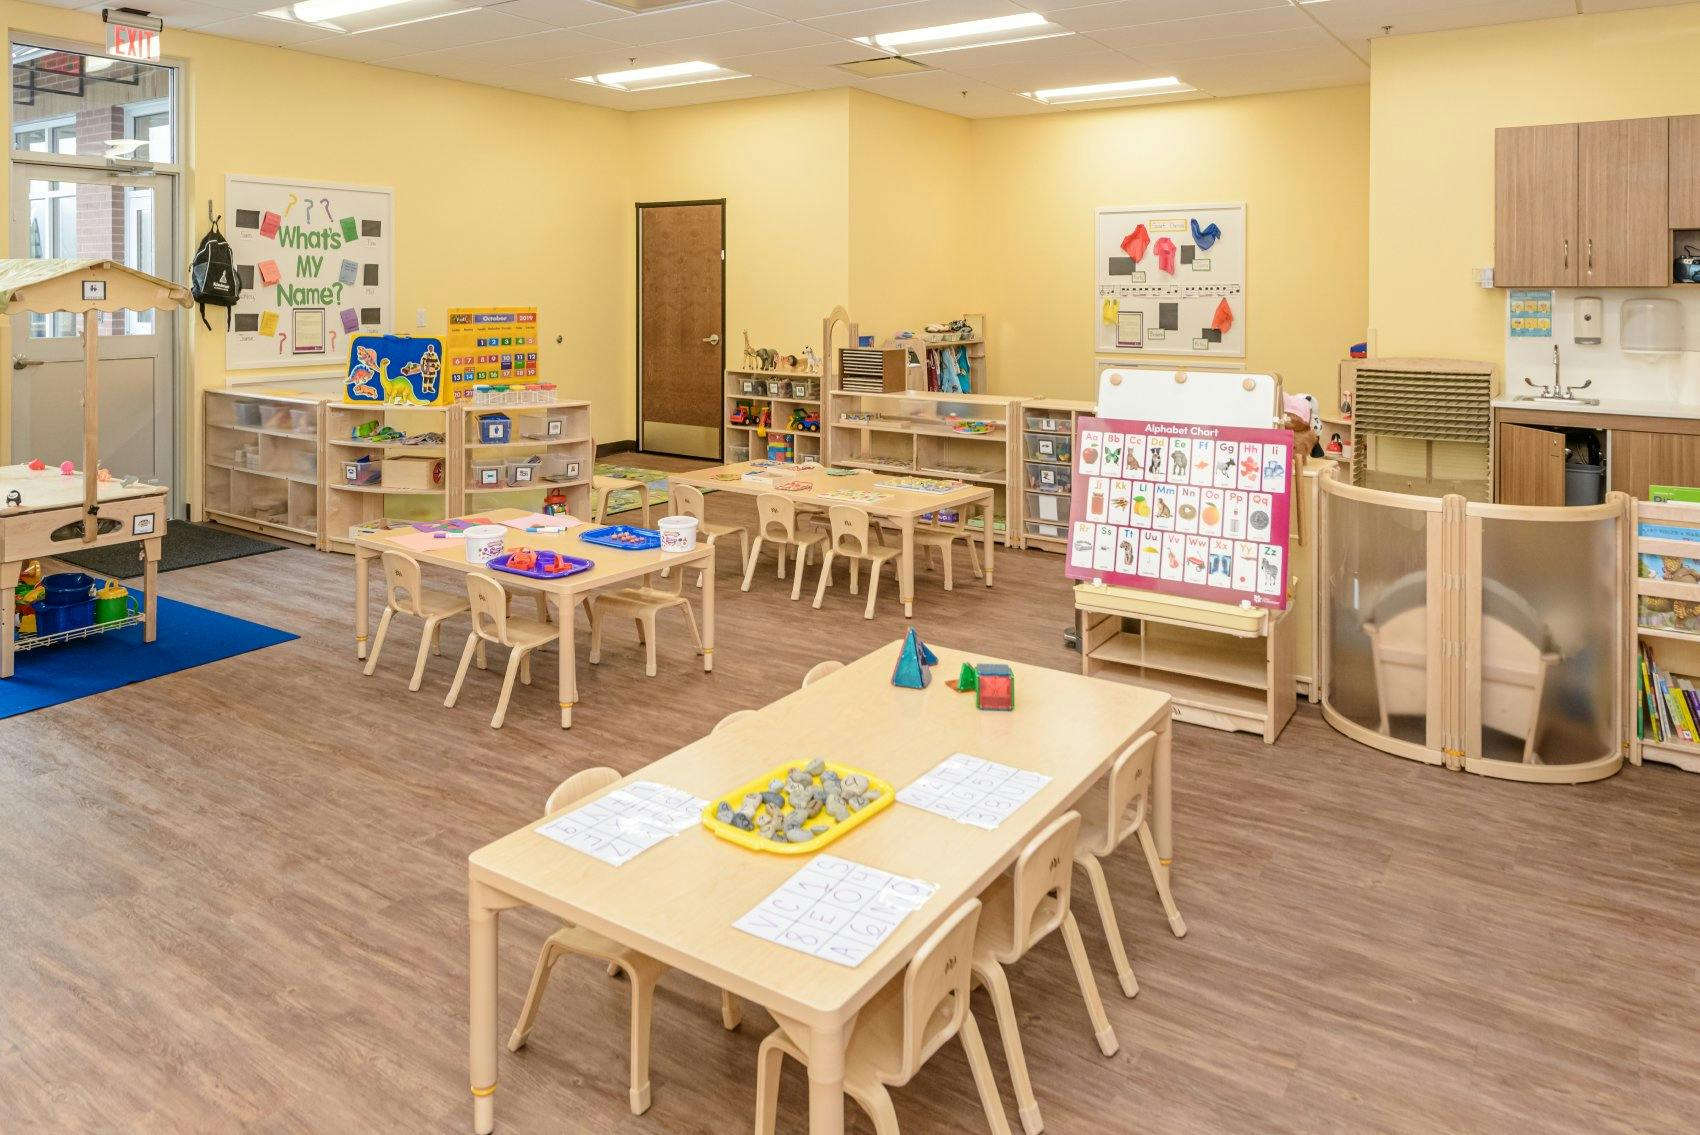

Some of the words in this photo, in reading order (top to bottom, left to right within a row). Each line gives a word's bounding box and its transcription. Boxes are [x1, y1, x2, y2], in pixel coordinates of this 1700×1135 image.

[114, 24, 153, 59] EXIT
[278, 225, 342, 250] What's
[296, 255, 324, 278] MY
[276, 282, 344, 307] Name?
[1144, 423, 1188, 436] Alphabet
[1190, 427, 1219, 437] Chart
[1085, 433, 1099, 441] Aa
[1108, 434, 1120, 443] Bb
[1129, 436, 1142, 445] Cc
[1151, 438, 1165, 447] Dd
[1174, 440, 1186, 448] Ee
[1199, 441, 1208, 450] Ff
[1219, 443, 1234, 454] Gg
[1244, 445, 1258, 454] Hh
[1115, 481, 1127, 490] Kk
[1139, 483, 1147, 492] Ll
[1157, 485, 1175, 495] Mm
[1182, 488, 1196, 497] Nn
[1205, 490, 1220, 499] Oo
[1230, 492, 1242, 503] Pp
[1253, 495, 1268, 507] Qq
[1079, 524, 1090, 533] Rr
[1101, 526, 1112, 536] Ss
[1124, 529, 1134, 538] Tt
[1145, 532, 1158, 541] Uu
[1168, 534, 1180, 544] Vv
[1188, 537, 1207, 547] Ww
[1215, 540, 1228, 550] Xx
[1240, 543, 1252, 553] Yy
[1265, 546, 1277, 556] Zz
